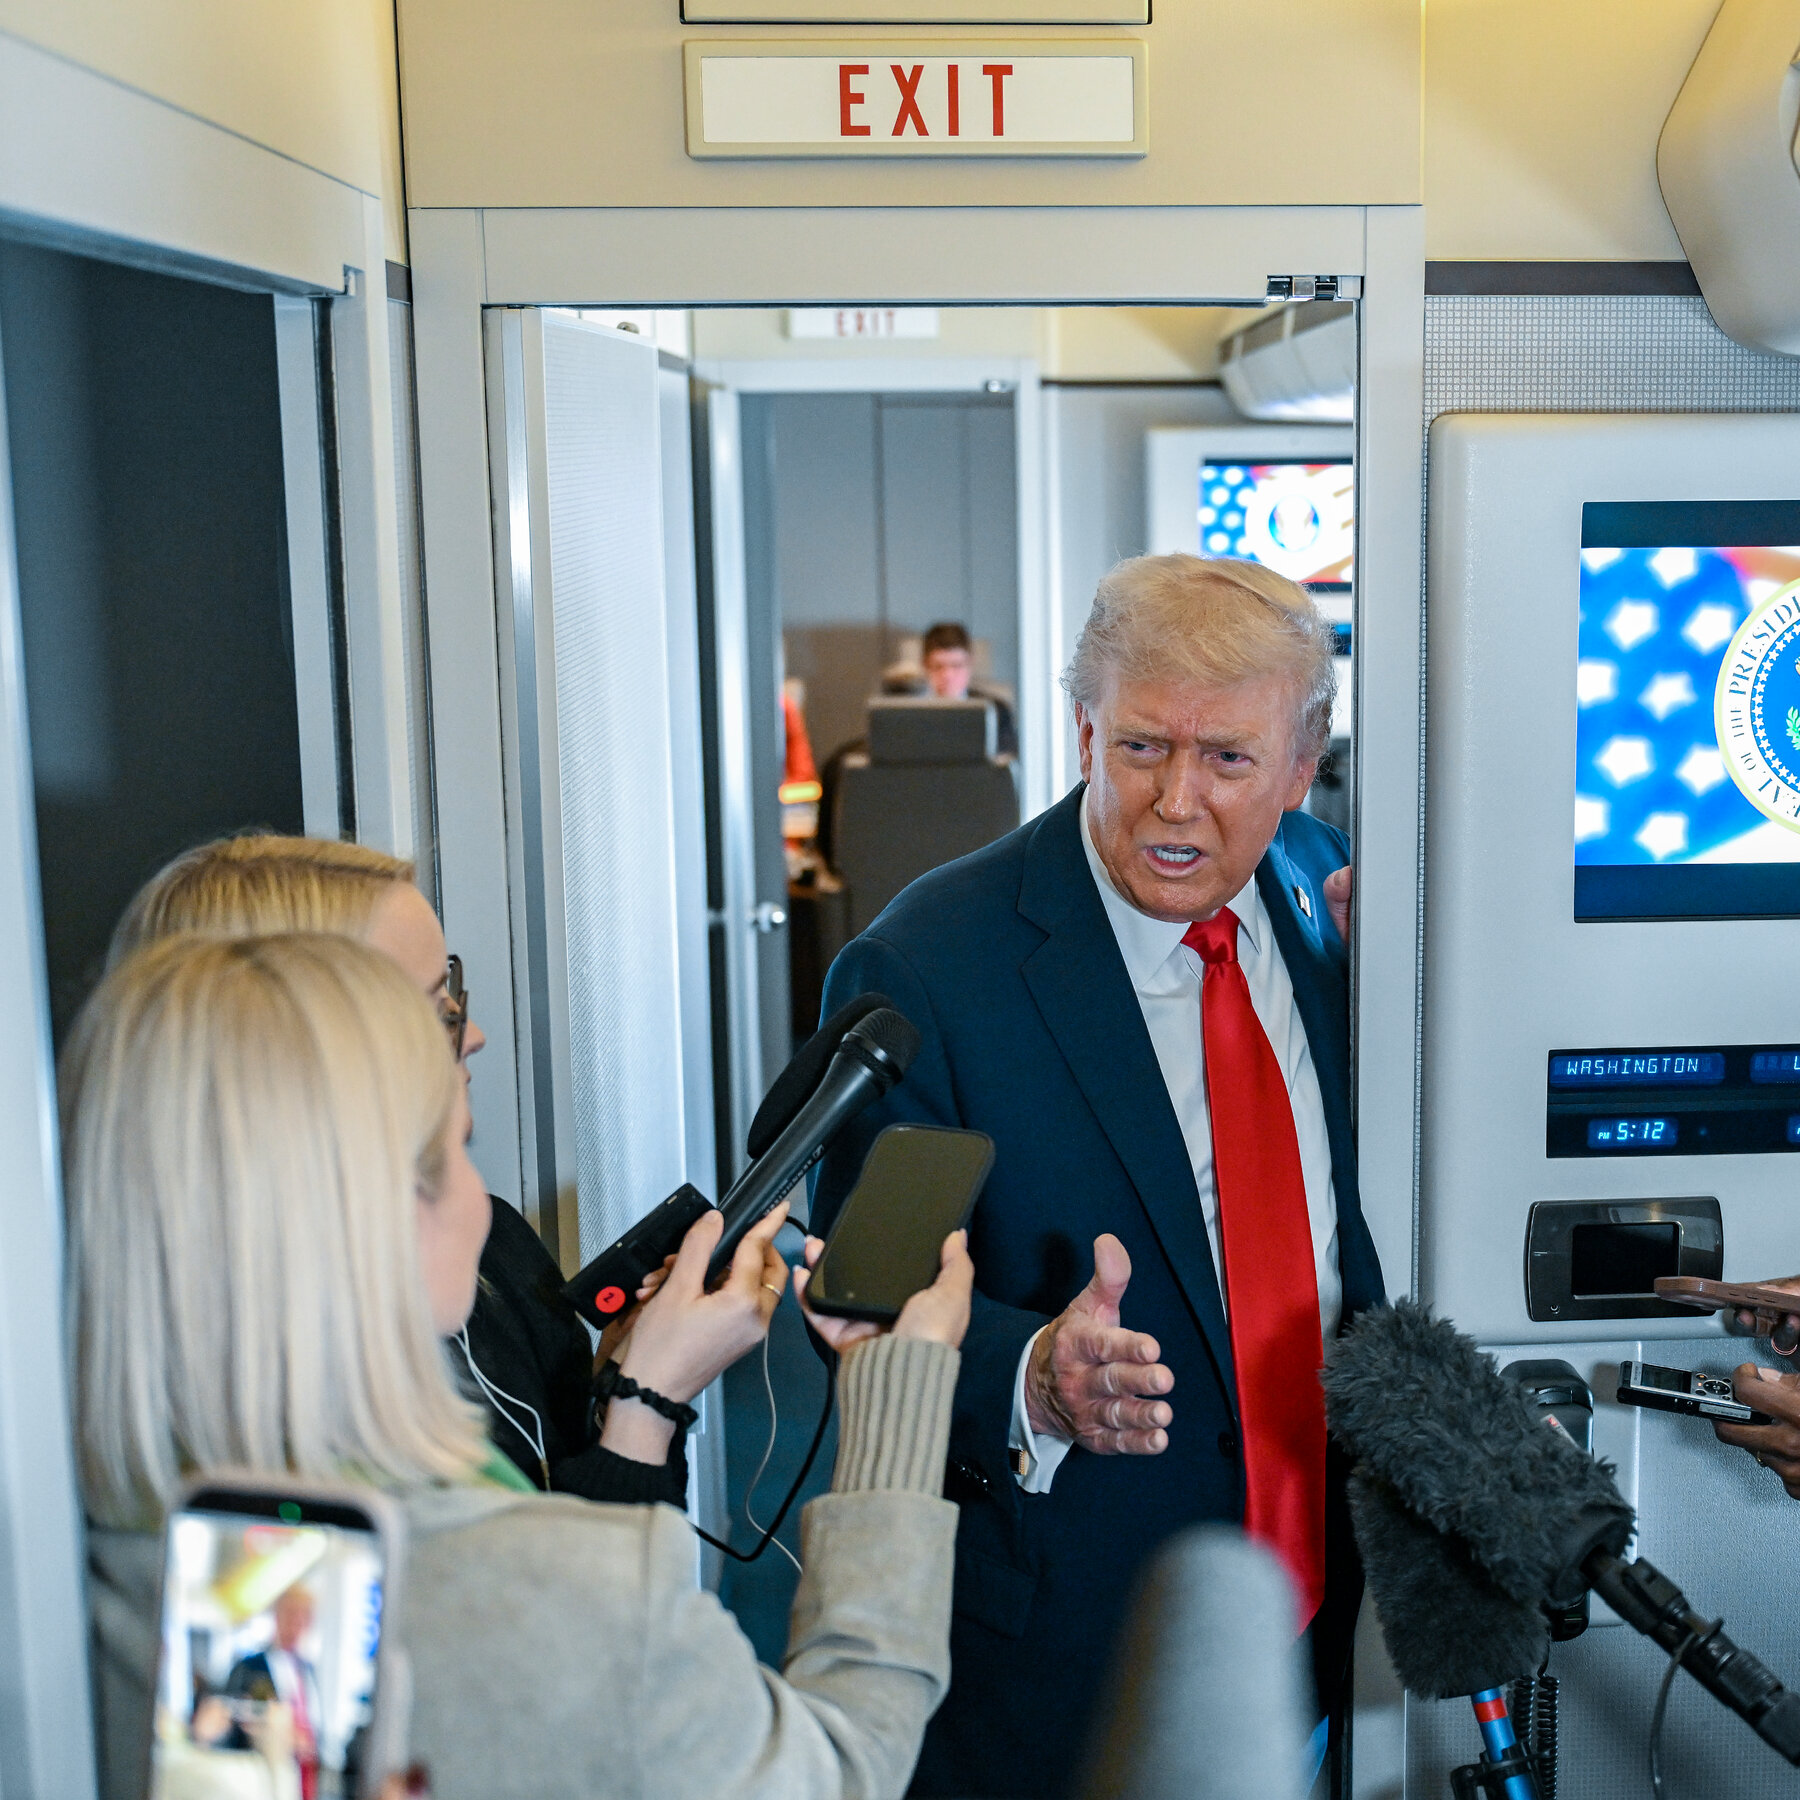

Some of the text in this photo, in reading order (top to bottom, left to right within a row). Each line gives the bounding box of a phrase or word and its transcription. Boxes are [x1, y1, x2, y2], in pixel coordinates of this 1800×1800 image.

[839, 64, 1013, 137] EXIT
[835, 311, 896, 337] EXIT
[1566, 1057, 1699, 1076] WASHINGTON
[1598, 1121, 1665, 1140] PM 5:12
